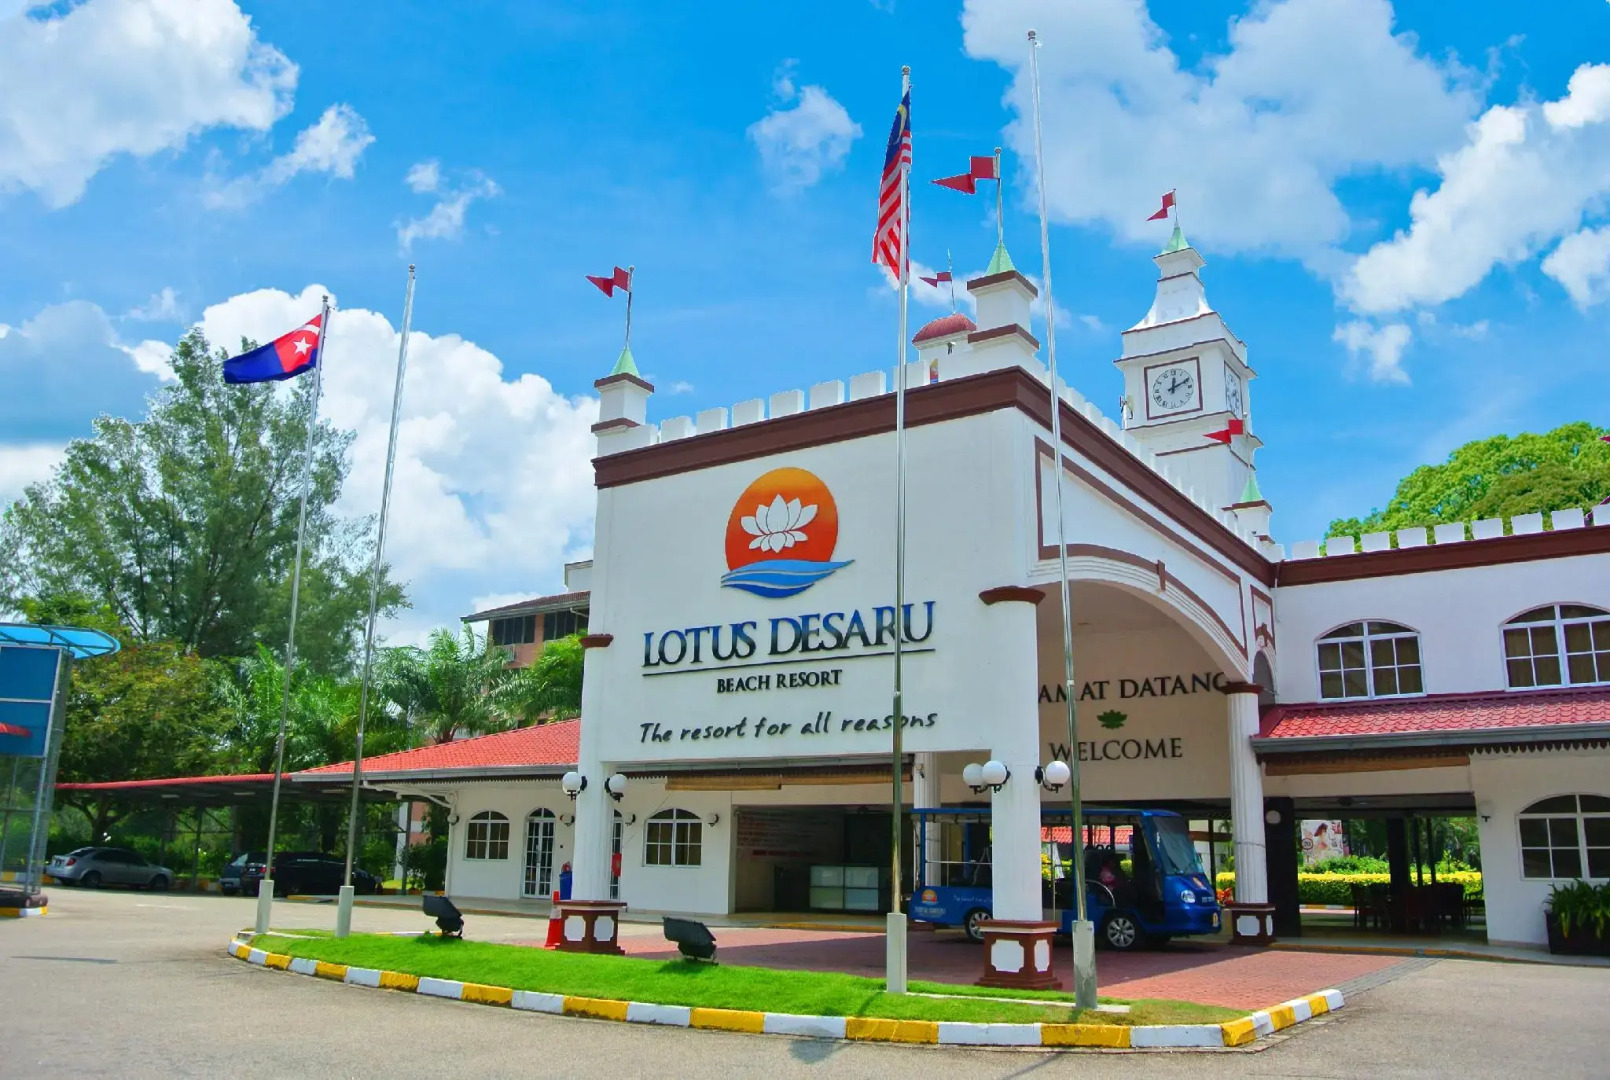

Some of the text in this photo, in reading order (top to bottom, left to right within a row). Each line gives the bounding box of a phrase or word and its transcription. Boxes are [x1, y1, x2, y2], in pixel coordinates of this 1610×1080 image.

[642, 601, 936, 667] LOTUS DESARU
[717, 669, 843, 693] BEACH RESORT
[640, 722, 672, 743] The
[679, 716, 746, 741] resort
[754, 717, 792, 738] for
[801, 711, 832, 735] all
[1049, 738, 1183, 762] WELCOME
